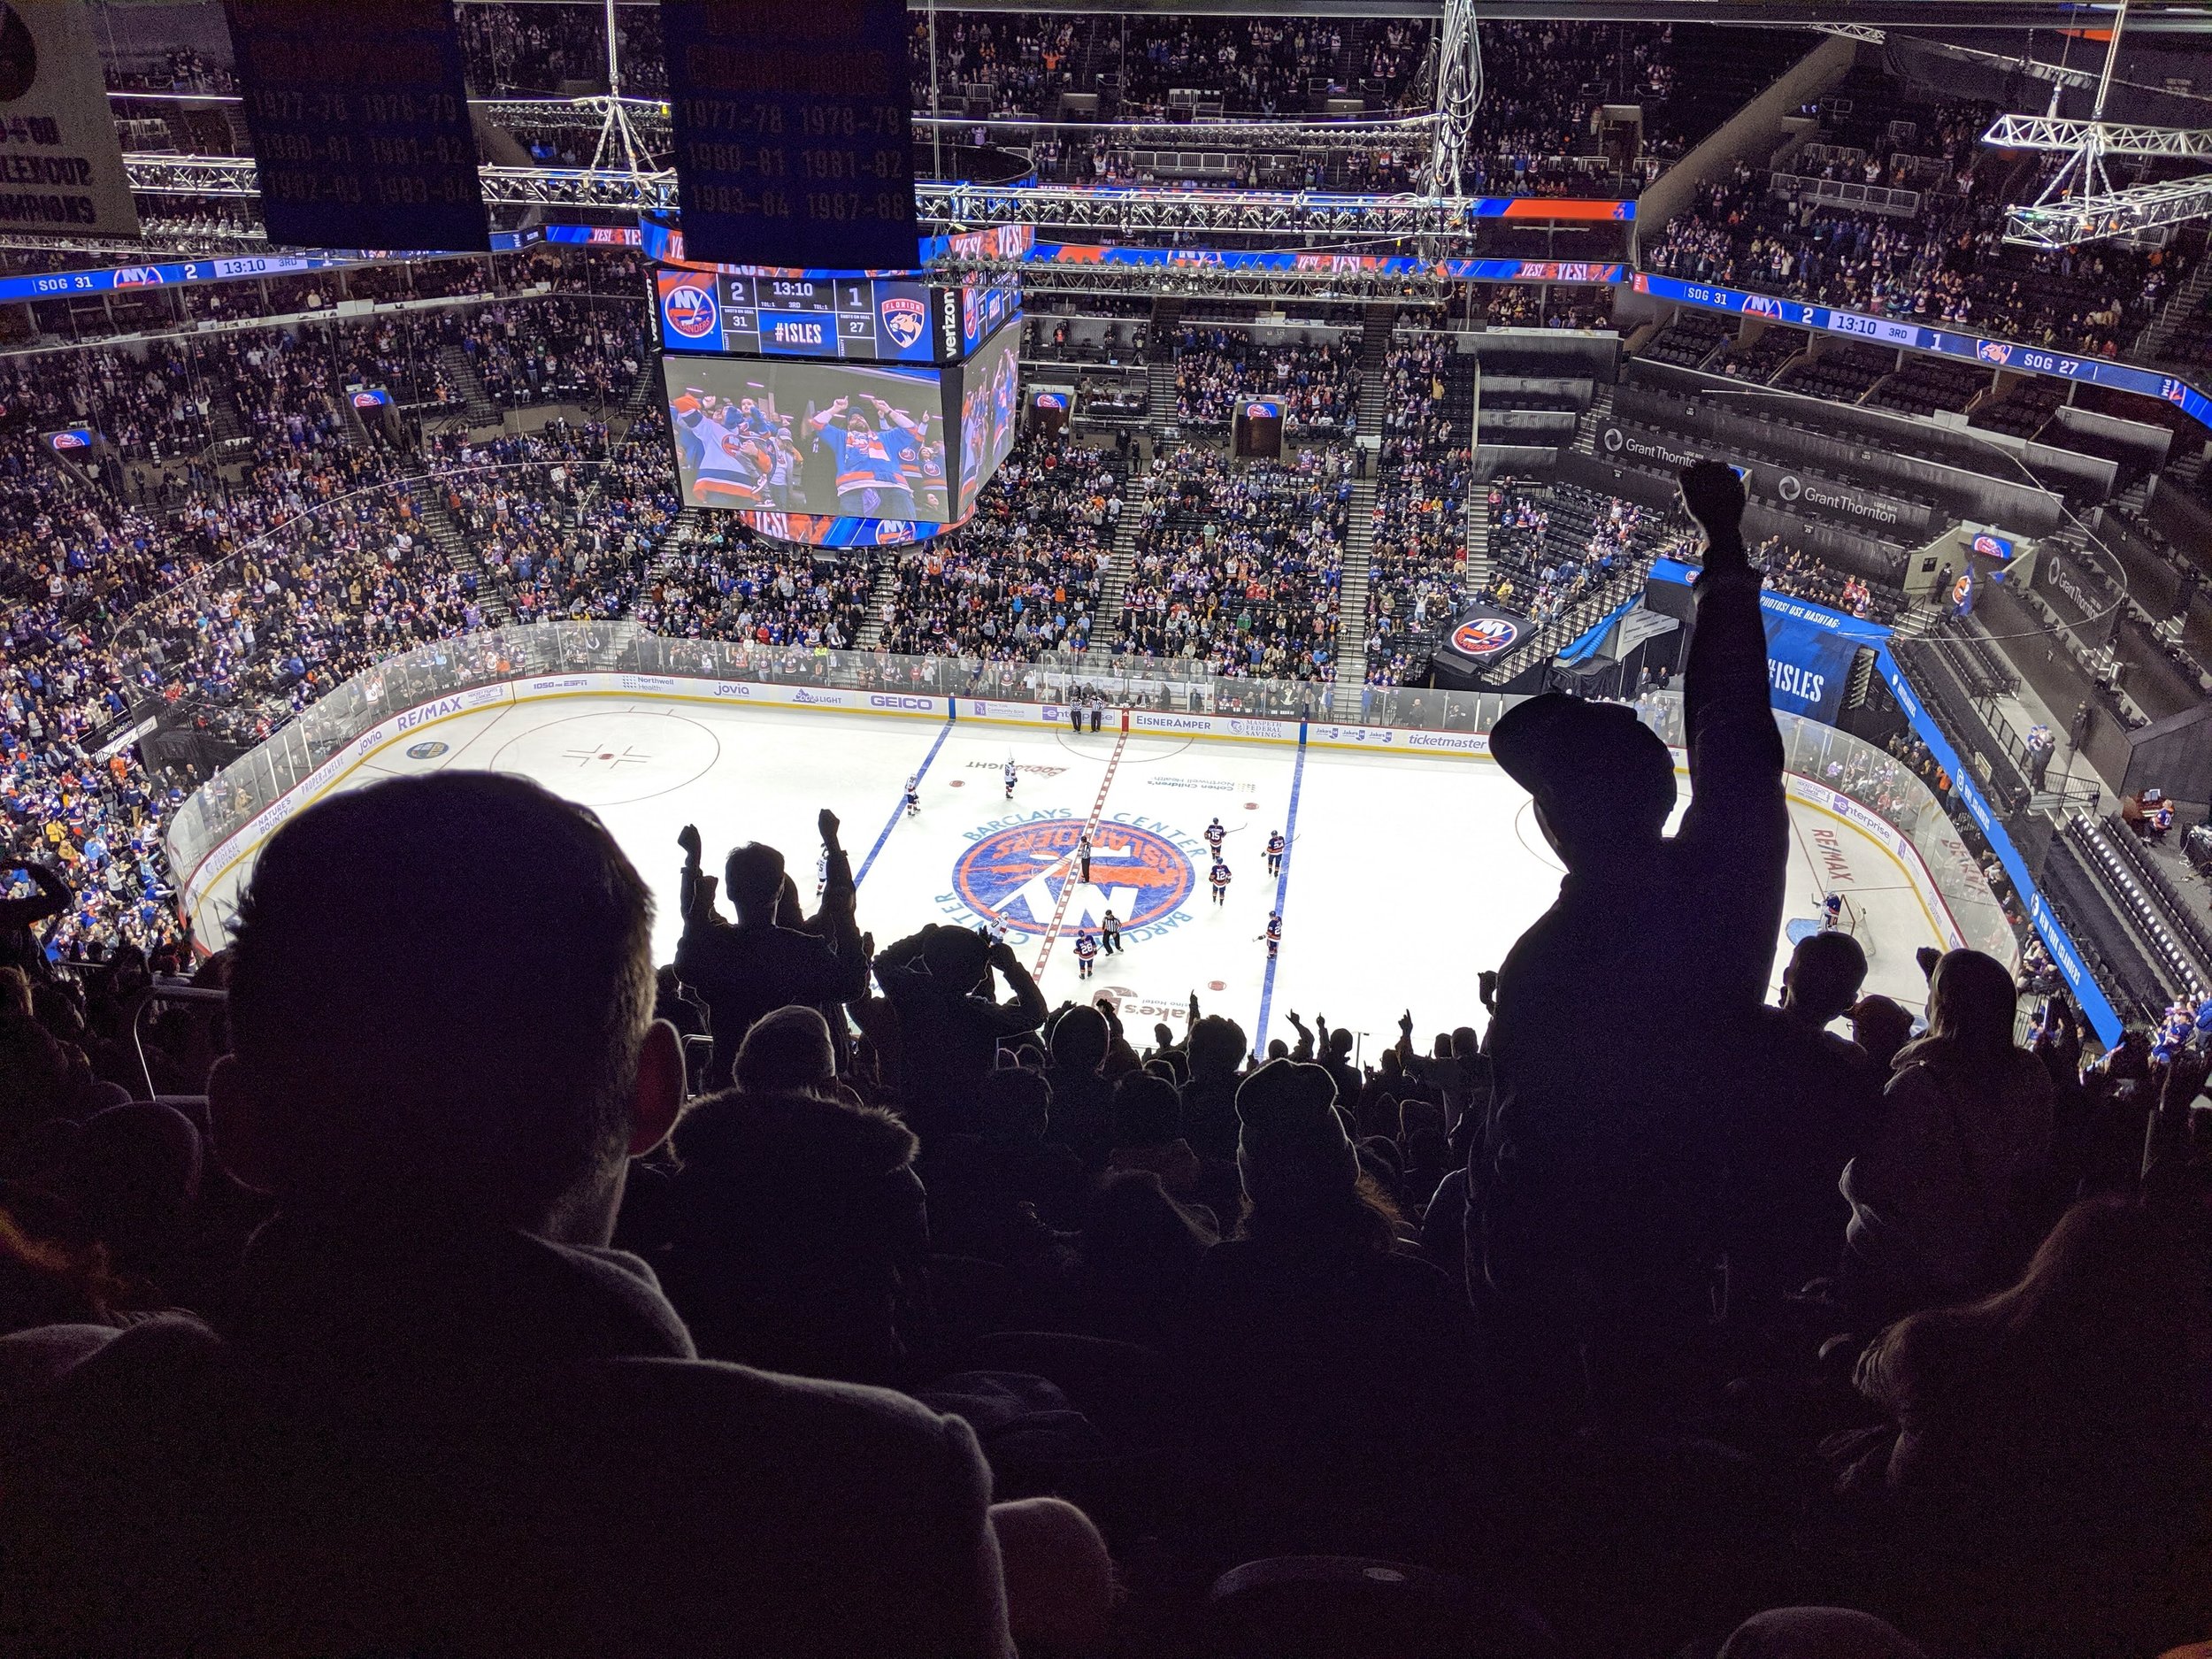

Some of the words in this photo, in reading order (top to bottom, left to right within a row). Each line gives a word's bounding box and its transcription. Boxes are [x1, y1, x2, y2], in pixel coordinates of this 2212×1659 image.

[682, 98, 783, 134] 1977-78
[798, 105, 901, 135] 1978-79
[687, 141, 785, 176] 1980-81
[802, 150, 902, 178] 1981-82
[690, 184, 789, 217] 1983-84
[806, 192, 905, 220] 1987-88
[594, 229, 611, 242] YES!
[184, 265, 198, 280] 2
[224, 258, 266, 274] 13:10
[279, 257, 298, 268] 3RD
[1521, 264, 1543, 276] YES!
[1557, 263, 1587, 280] YES!
[39, 279, 68, 291] SOG
[75, 275, 93, 288] 31
[730, 282, 744, 301] 2
[772, 281, 813, 296] 13:10
[849, 288, 863, 306] 1
[1687, 288, 1709, 301] SOG
[1714, 293, 1727, 305] 31
[646, 278, 658, 342] verizon
[886, 302, 920, 311] FLORIDA
[1801, 307, 1814, 324] 2
[733, 316, 748, 326] 31
[849, 322, 864, 333] 27
[942, 291, 956, 358] verizon
[1836, 315, 1877, 335] 13:10
[1888, 327, 1907, 339] 3RD
[774, 322, 822, 344] #ISLES
[1930, 334, 1942, 351] 1
[2024, 353, 2053, 370] SOG
[2059, 359, 2079, 375] 27
[2162, 379, 2172, 396] PIM
[1626, 438, 1655, 458] Grant
[1805, 487, 1839, 509] Grant
[1840, 495, 1896, 524] Thornton
[756, 511, 788, 539] YES!
[1760, 595, 1790, 613] PHOTOS!
[1789, 605, 1805, 618] USE
[1803, 610, 1840, 628] HASHTAG:
[637, 676, 674, 686] Northwell
[714, 682, 749, 696] jovia
[1768, 658, 1824, 703] #ISLES
[870, 695, 933, 710] GEICO
[397, 696, 463, 732] RE/MAX
[357, 730, 382, 756] jovia
[1409, 733, 1486, 749] ticketmaster
[965, 761, 1003, 770] IGHT
[301, 776, 324, 795] PROPER
[325, 757, 344, 780] TWELVE
[1147, 780, 1199, 789] Children's
[257, 796, 292, 827] NATURE'S
[1835, 799, 1890, 840] enterprise
[259, 808, 288, 835] BOUNTY
[963, 808, 1072, 841] BARCLAYS
[1113, 812, 1207, 858] CENTER
[1210, 831, 1220, 840] 15
[1811, 829, 1855, 882] RE/MAX
[1216, 872, 1225, 880] 12
[1080, 943, 1093, 954] 28
[2039, 910, 2048, 933] NEW
[2047, 928, 2059, 951] YORK
[2057, 944, 2080, 986] ISLANDERS
